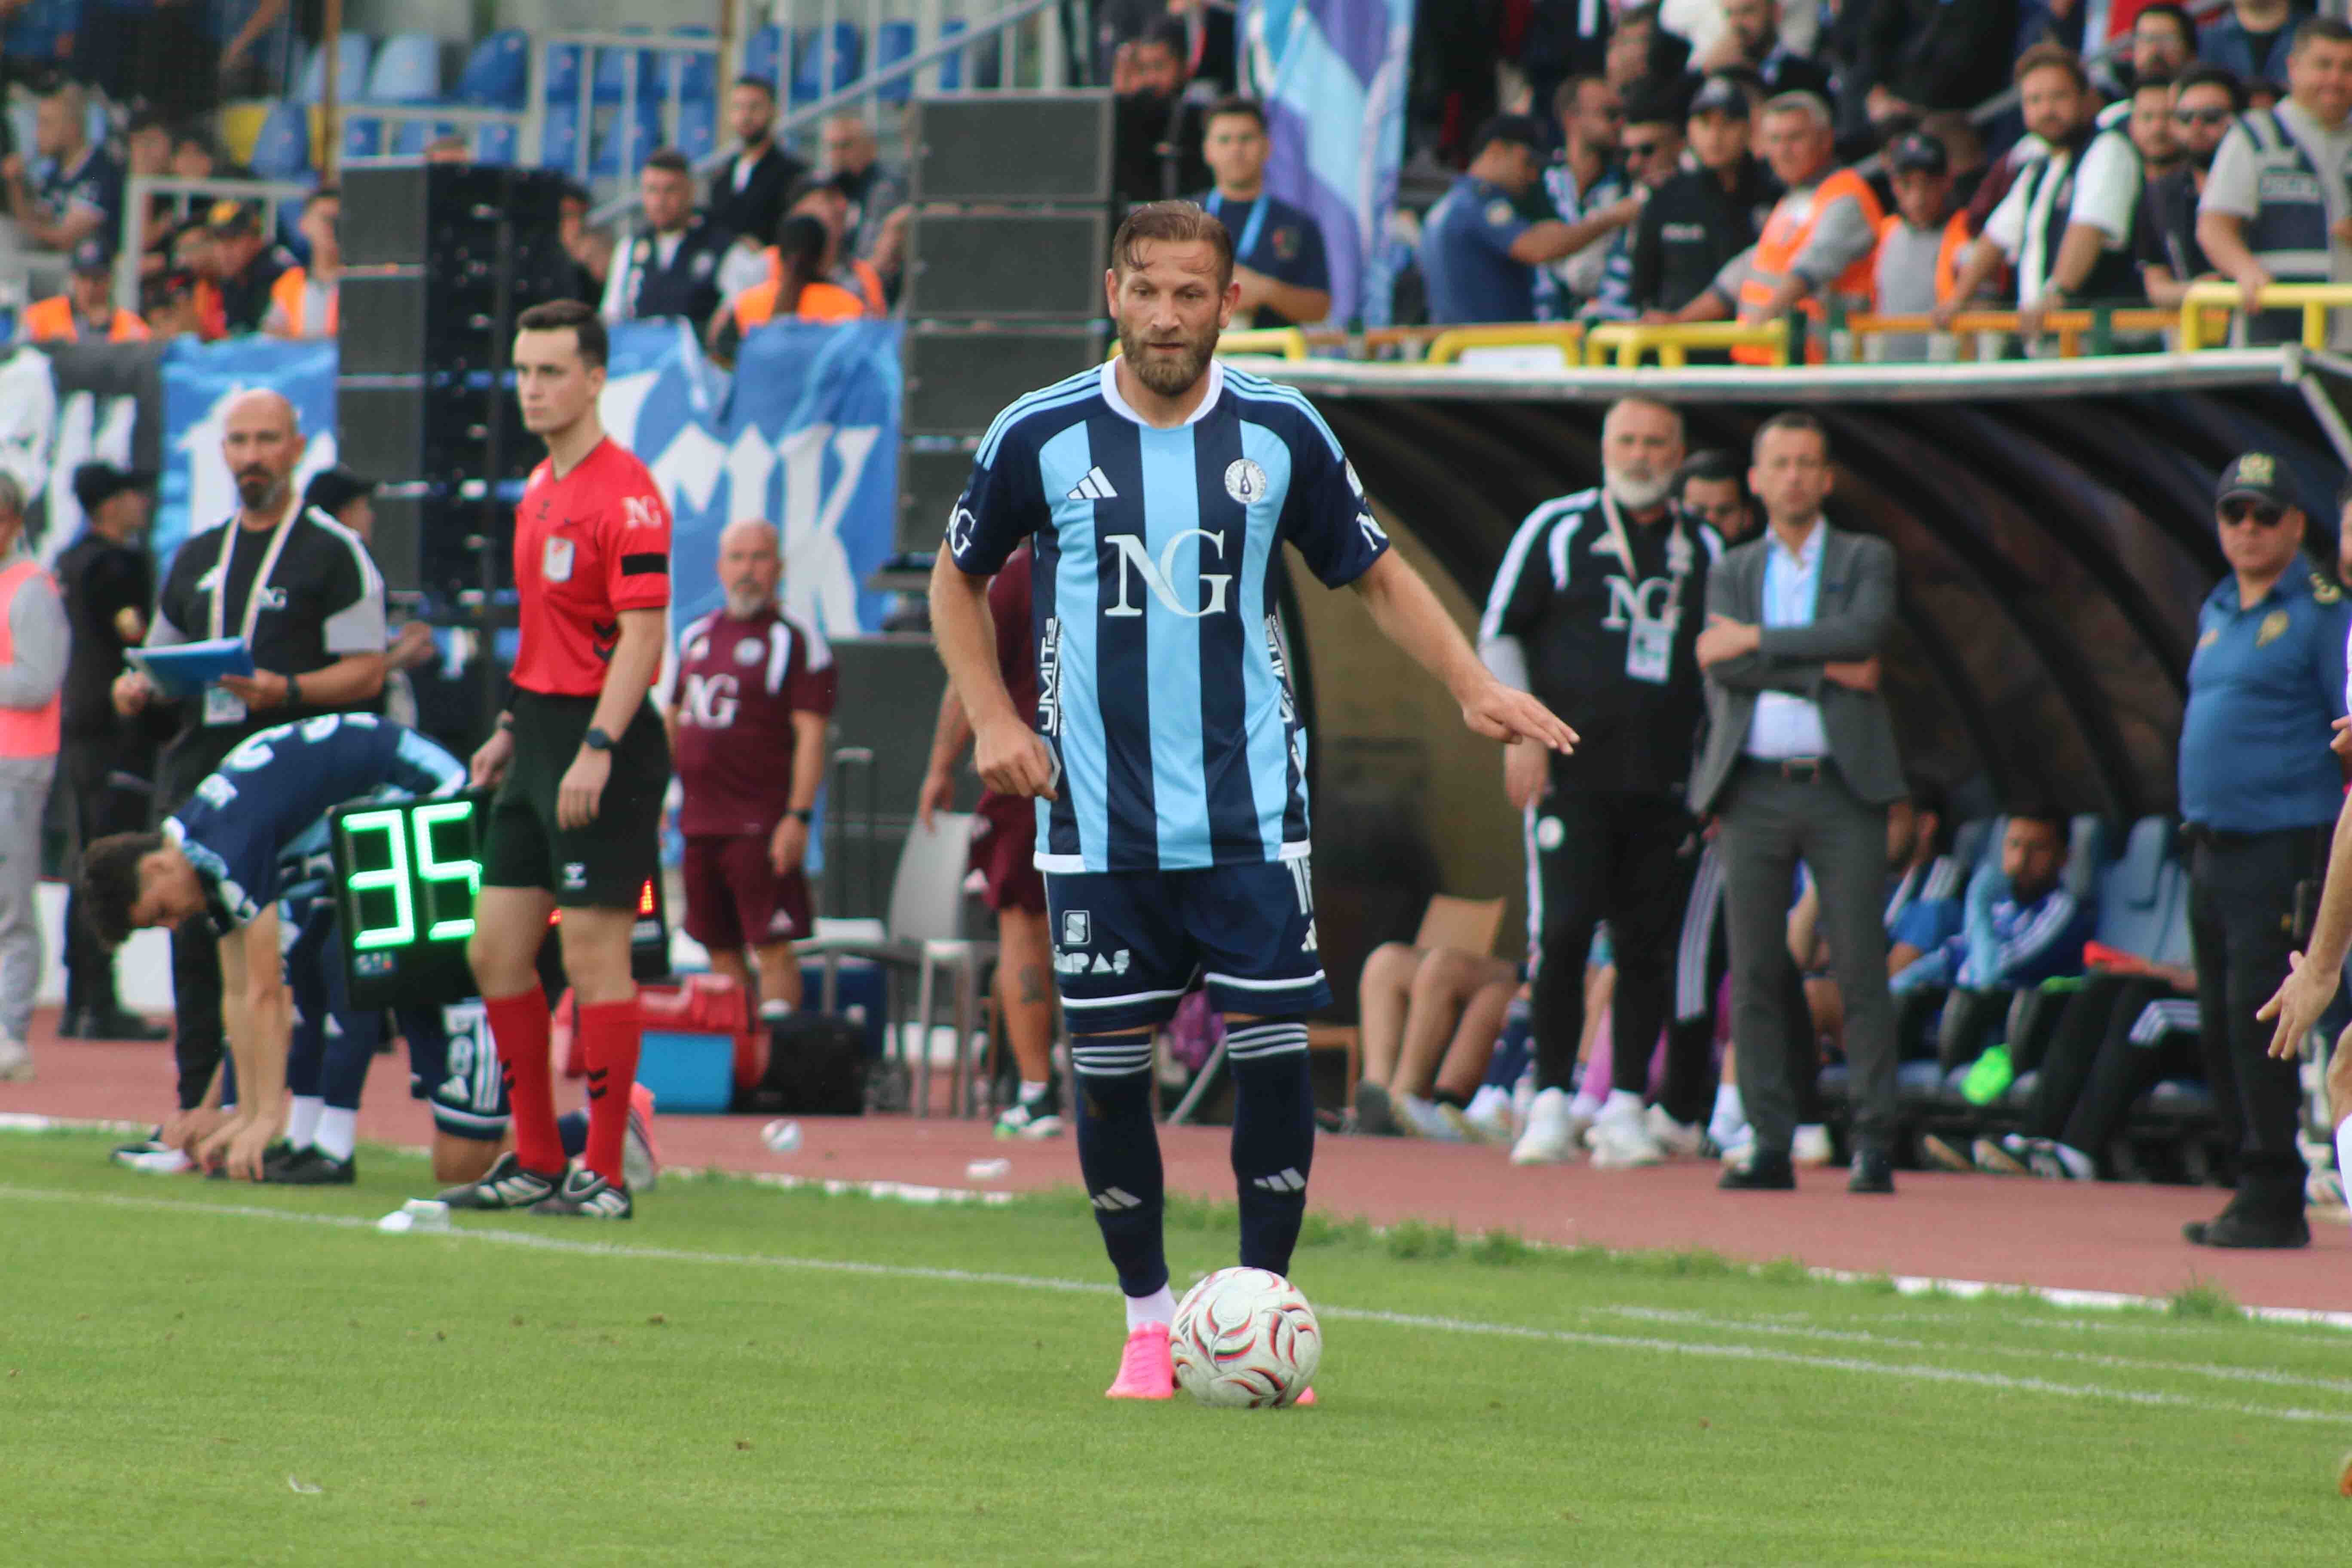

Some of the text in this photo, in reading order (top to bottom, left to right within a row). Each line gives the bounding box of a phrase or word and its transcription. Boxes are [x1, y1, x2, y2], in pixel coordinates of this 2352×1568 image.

[622, 495, 662, 529] NG
[1103, 529, 1233, 617] NG
[1602, 575, 1682, 631] NG
[343, 801, 482, 949] 35
